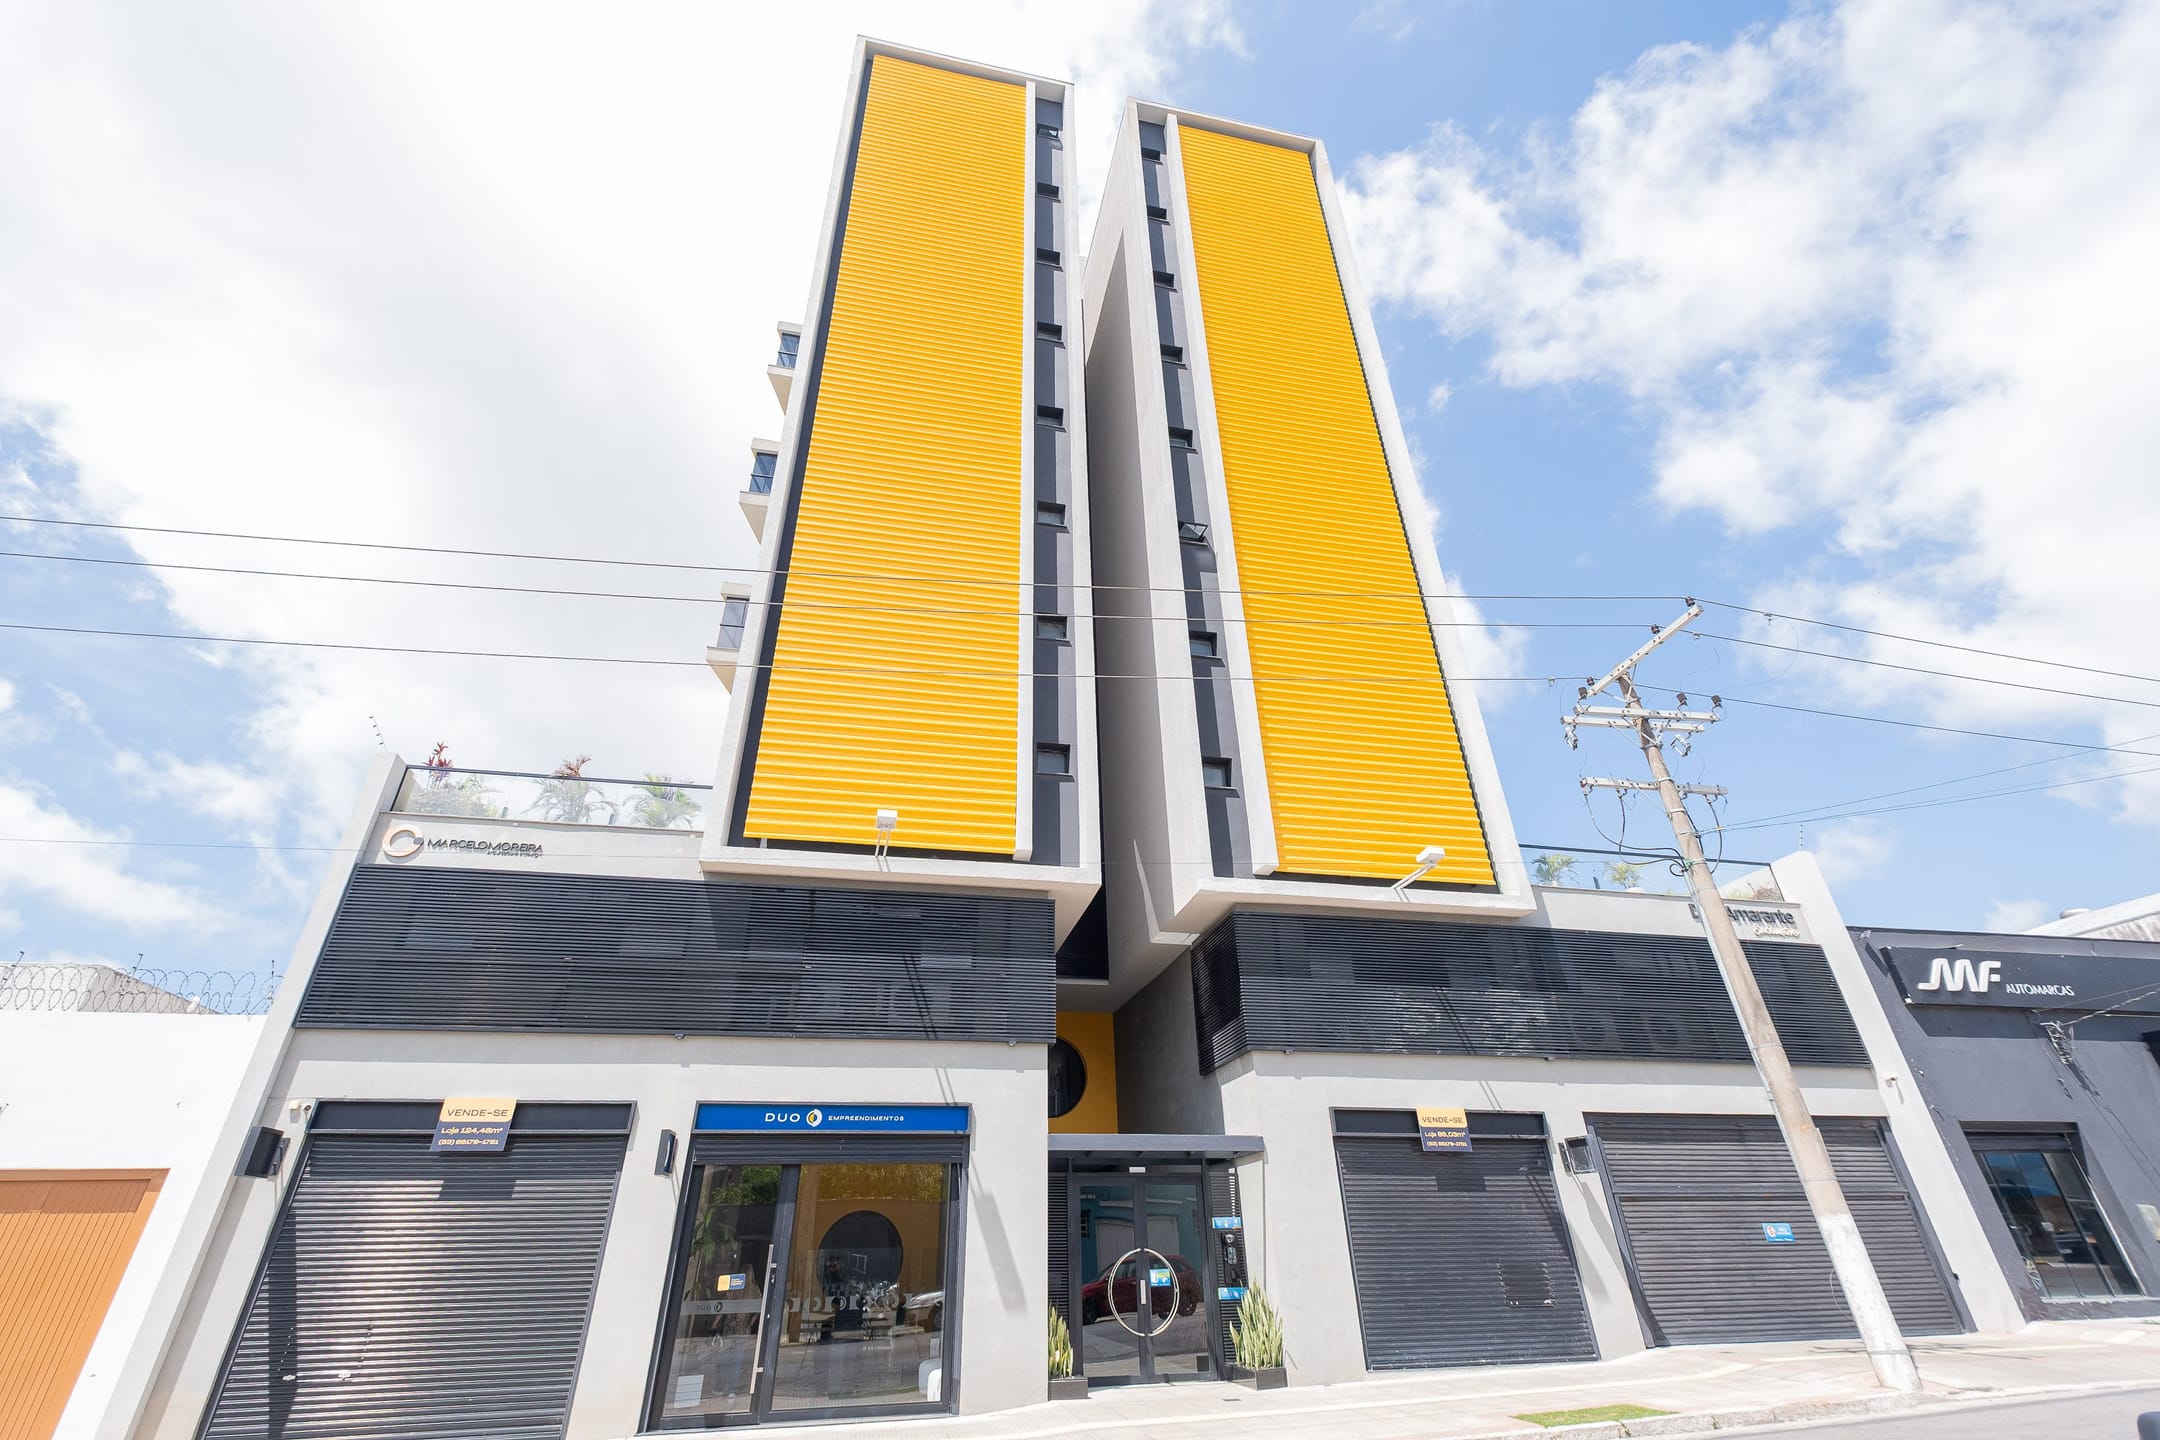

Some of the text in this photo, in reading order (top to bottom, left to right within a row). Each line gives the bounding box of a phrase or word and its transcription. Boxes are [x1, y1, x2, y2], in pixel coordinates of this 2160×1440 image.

[2006, 983, 2075, 996] AUTOMARCAS
[447, 1109, 509, 1117] VENDE-SE
[765, 1112, 801, 1123] DUO
[1421, 1116, 1463, 1124] VENDE-SE
[441, 1126, 459, 1135] Loja
